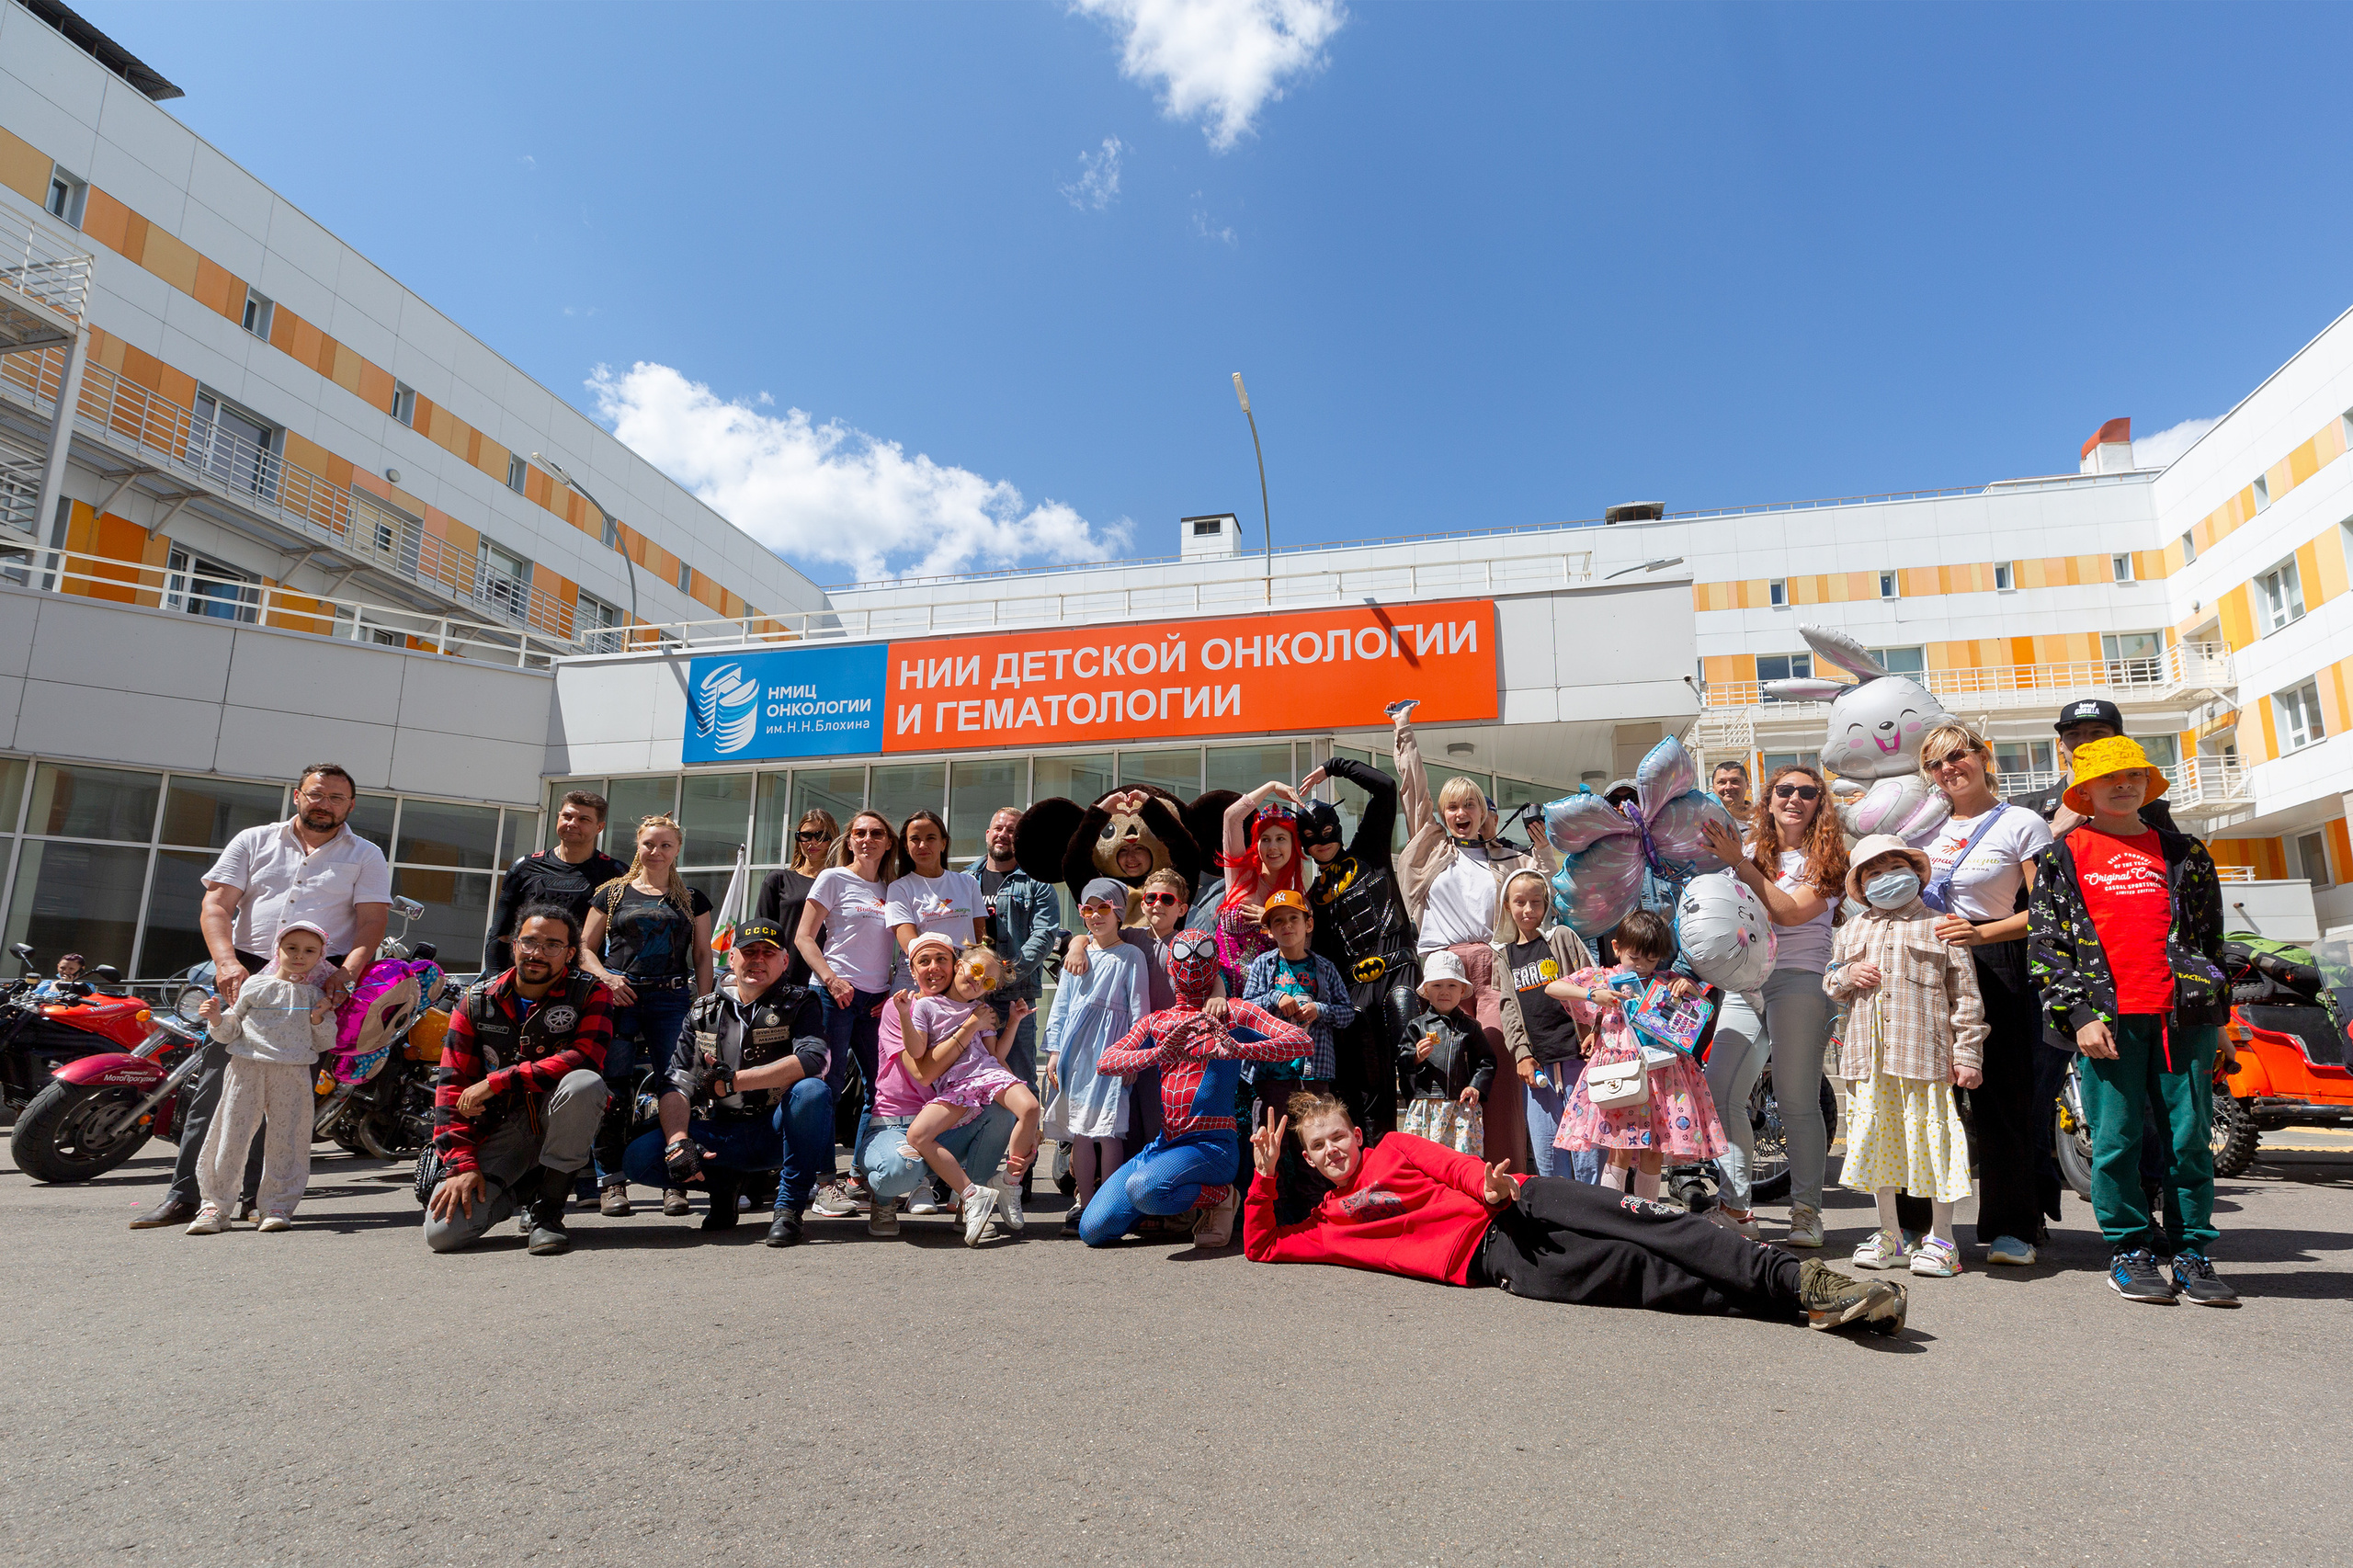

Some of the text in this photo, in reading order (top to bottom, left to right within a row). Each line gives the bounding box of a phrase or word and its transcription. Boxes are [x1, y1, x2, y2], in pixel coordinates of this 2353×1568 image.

[900, 620, 1477, 690] НИИ ДЕТСКОЙ ОНКОЛОГИИ
[767, 685, 817, 700] НМИЦ
[767, 699, 871, 718] ОНКОЛОГИИ
[896, 684, 1241, 735] И ГЕМАТОЛОГИИ
[2074, 707, 2100, 716] GORILLA
[2108, 854, 2122, 865] BEST
[2084, 867, 2165, 886] Original Compa
[87, 1003, 125, 1013] TRIUMPH
[103, 1074, 158, 1084] МотоПрогулки
